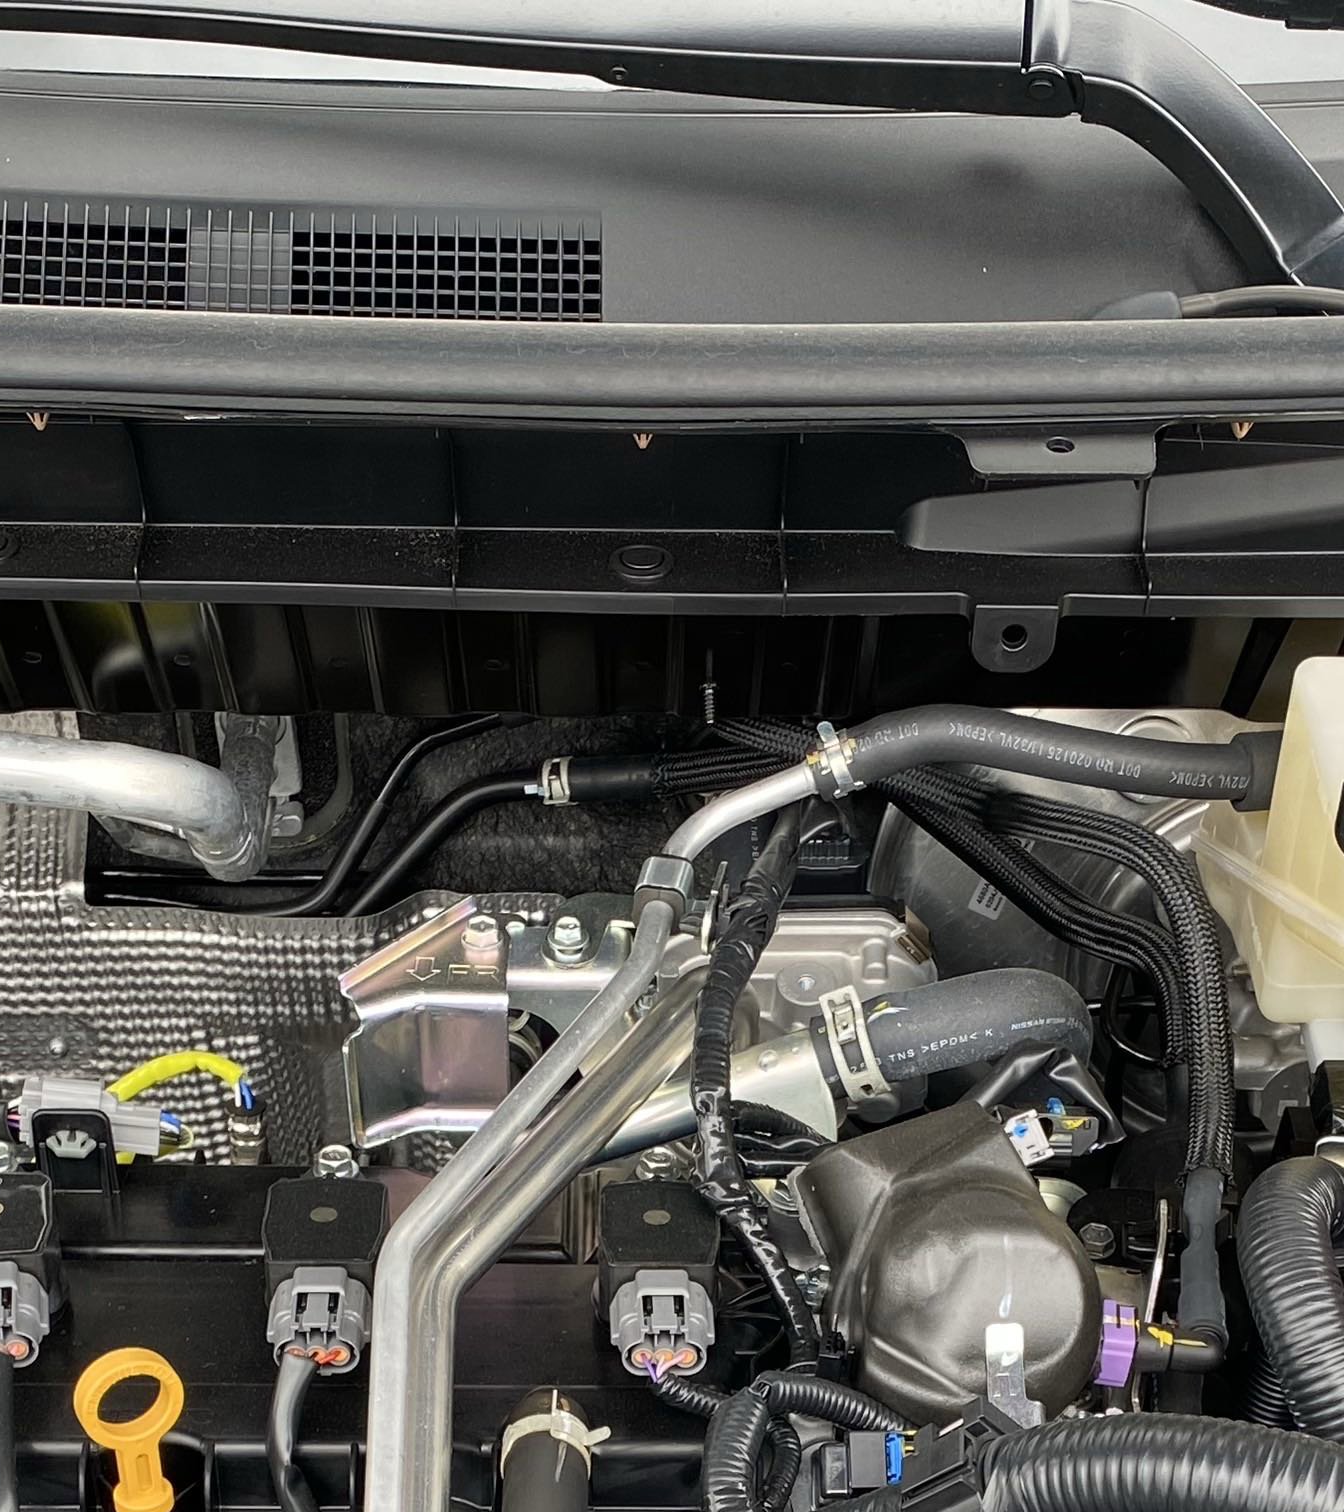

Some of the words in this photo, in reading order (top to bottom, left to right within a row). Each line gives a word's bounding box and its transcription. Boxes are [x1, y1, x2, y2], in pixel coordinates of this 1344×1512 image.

[1117, 763, 1141, 779] DOT
[447, 964, 499, 984] FR
[1011, 1017, 1045, 1031] NISSAN
[888, 1049, 915, 1064] TNS
[921, 1033, 978, 1053] >EPDM<
[985, 1028, 993, 1038] K
